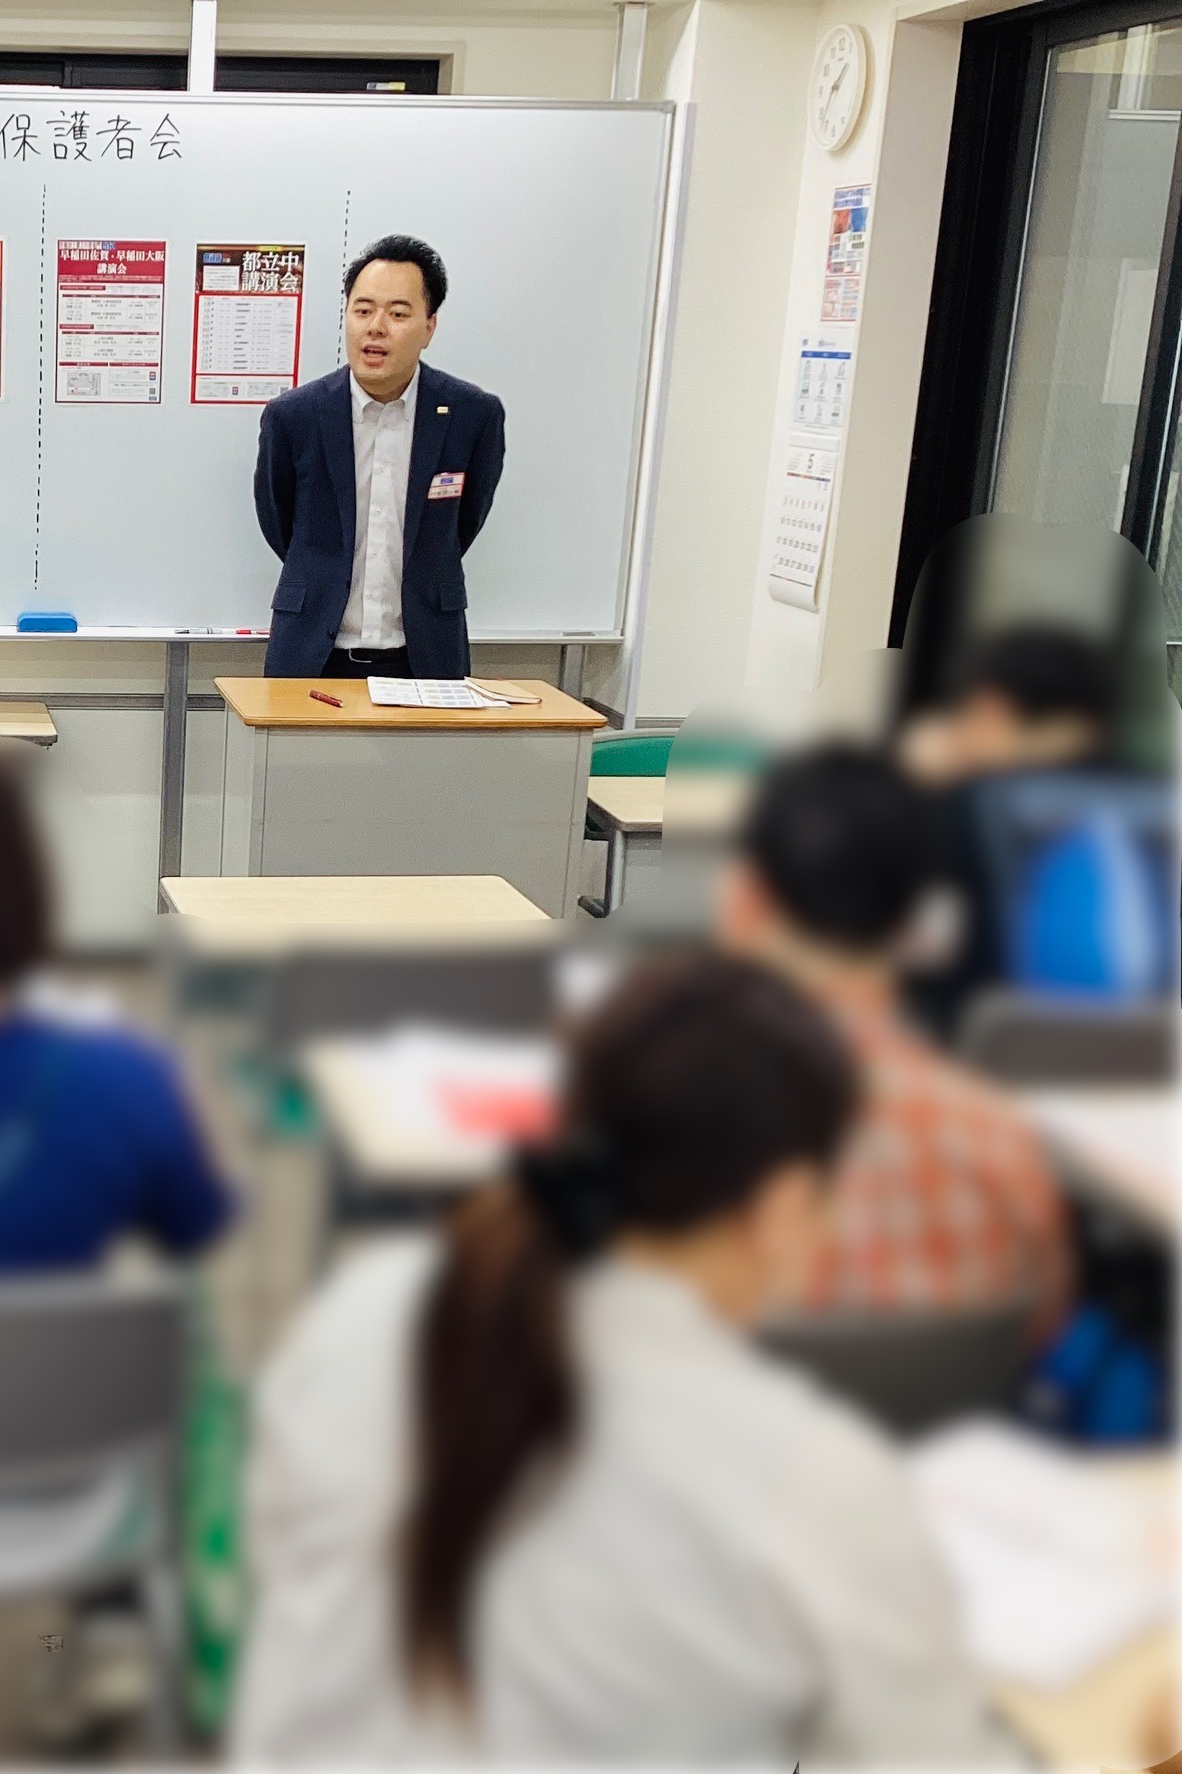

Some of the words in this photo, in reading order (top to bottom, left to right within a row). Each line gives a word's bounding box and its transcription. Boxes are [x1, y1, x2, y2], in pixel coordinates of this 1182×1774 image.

[60, 250, 164, 261] 早稲田佐賀・早稲田大阪
[242, 251, 299, 272] 都立中
[97, 263, 127, 274] 講演会
[241, 271, 299, 292] 講演会
